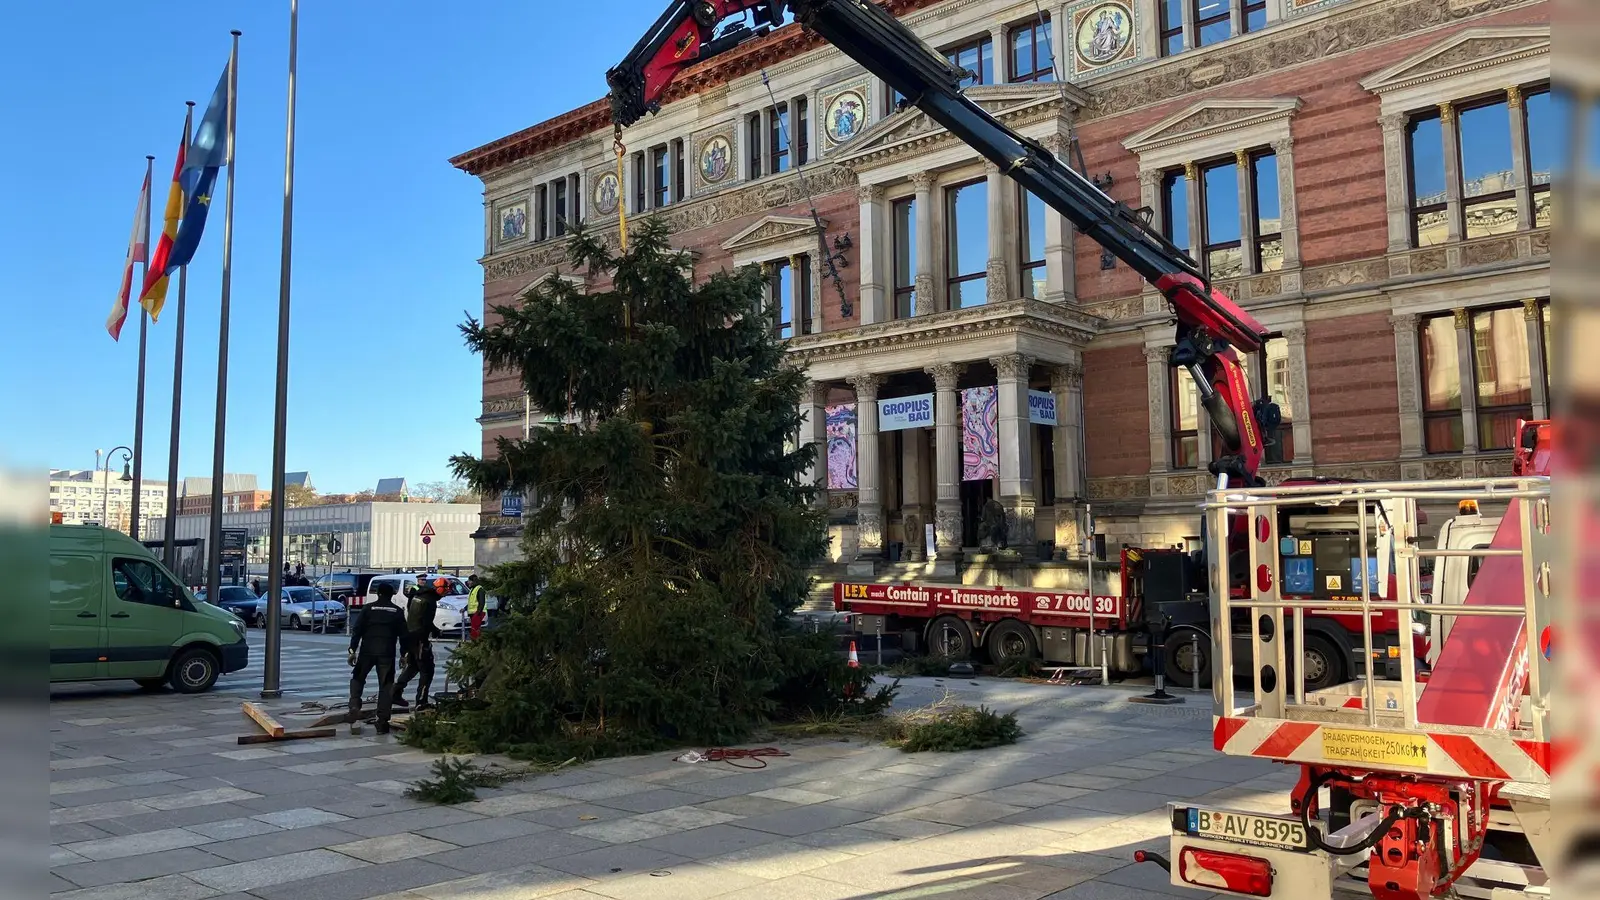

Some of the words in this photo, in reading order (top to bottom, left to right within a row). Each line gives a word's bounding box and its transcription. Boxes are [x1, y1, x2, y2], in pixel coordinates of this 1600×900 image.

[882, 398, 930, 416] GROPIUS
[1028, 395, 1055, 410] ROPIUS
[908, 411, 930, 422] BAU
[1039, 409, 1055, 420] BAU
[844, 584, 868, 598] LEX
[886, 586, 943, 602] Containr
[951, 589, 1019, 608] Transporte
[1054, 595, 1064, 610] 7
[1066, 595, 1091, 612] 000
[1095, 597, 1113, 613] 30
[1322, 732, 1385, 745] DRAAGVERMOGEN
[1199, 811, 1211, 831] B
[1224, 815, 1249, 836] AV
[1253, 819, 1303, 844] 8595
